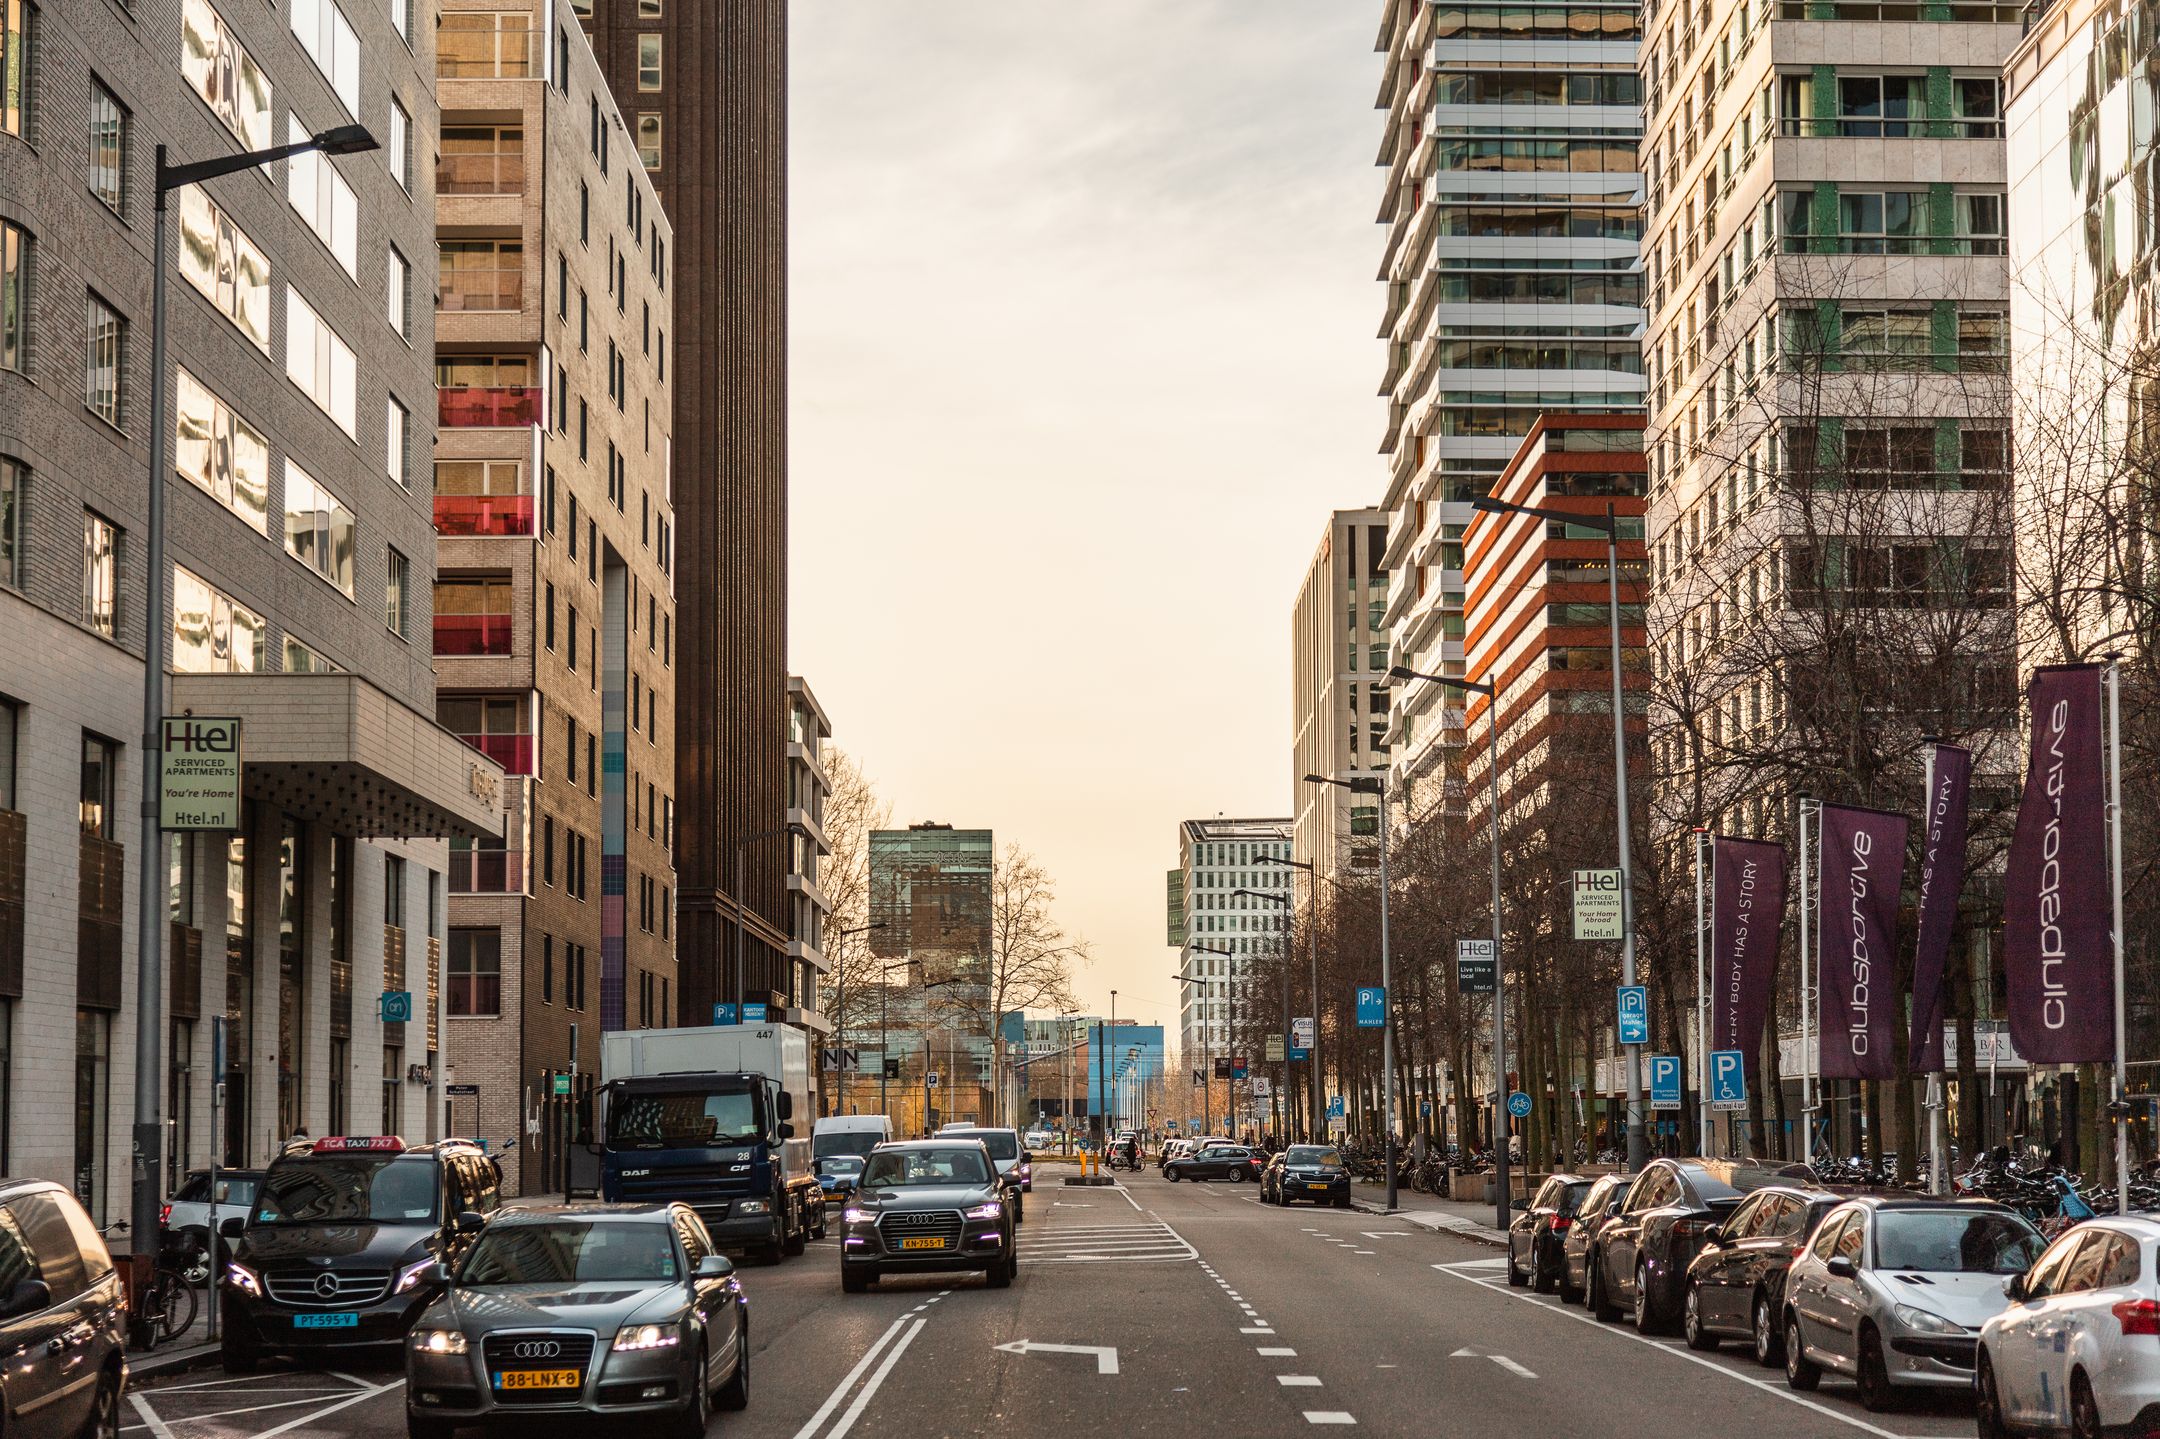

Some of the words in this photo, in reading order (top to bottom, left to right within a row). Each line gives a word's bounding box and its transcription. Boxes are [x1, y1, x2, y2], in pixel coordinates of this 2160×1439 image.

[165, 722, 236, 752] Htel
[174, 759, 226, 767] SERVICED
[165, 768, 236, 776] APARTMENTS
[165, 789, 199, 798] You're
[202, 789, 234, 798] Home
[1931, 774, 1952, 842] STORY
[175, 812, 225, 825] Htel.nl
[1928, 848, 1938, 862] A
[1575, 872, 1619, 891] Htel
[1738, 859, 1757, 908] STORY
[1738, 913, 1750, 924] A
[1583, 929, 1615, 937] Htel.nl
[1460, 942, 1492, 955] Htel
[1734, 927, 1748, 957] HAS
[1850, 831, 1872, 1056] clubsportive
[1730, 961, 1742, 1003] BODY
[756, 1031, 773, 1039] 447
[1658, 1061, 1673, 1082] P
[1718, 1056, 1736, 1080] P
[324, 1140, 344, 1148] TCA
[346, 1140, 369, 1148] TAXI
[370, 1139, 393, 1147] 7X7
[738, 1152, 750, 1160] 28
[905, 1240, 942, 1249] KN-755-T
[301, 1315, 351, 1325] PT-595-V
[507, 1372, 577, 1387] 88-LNX-8
